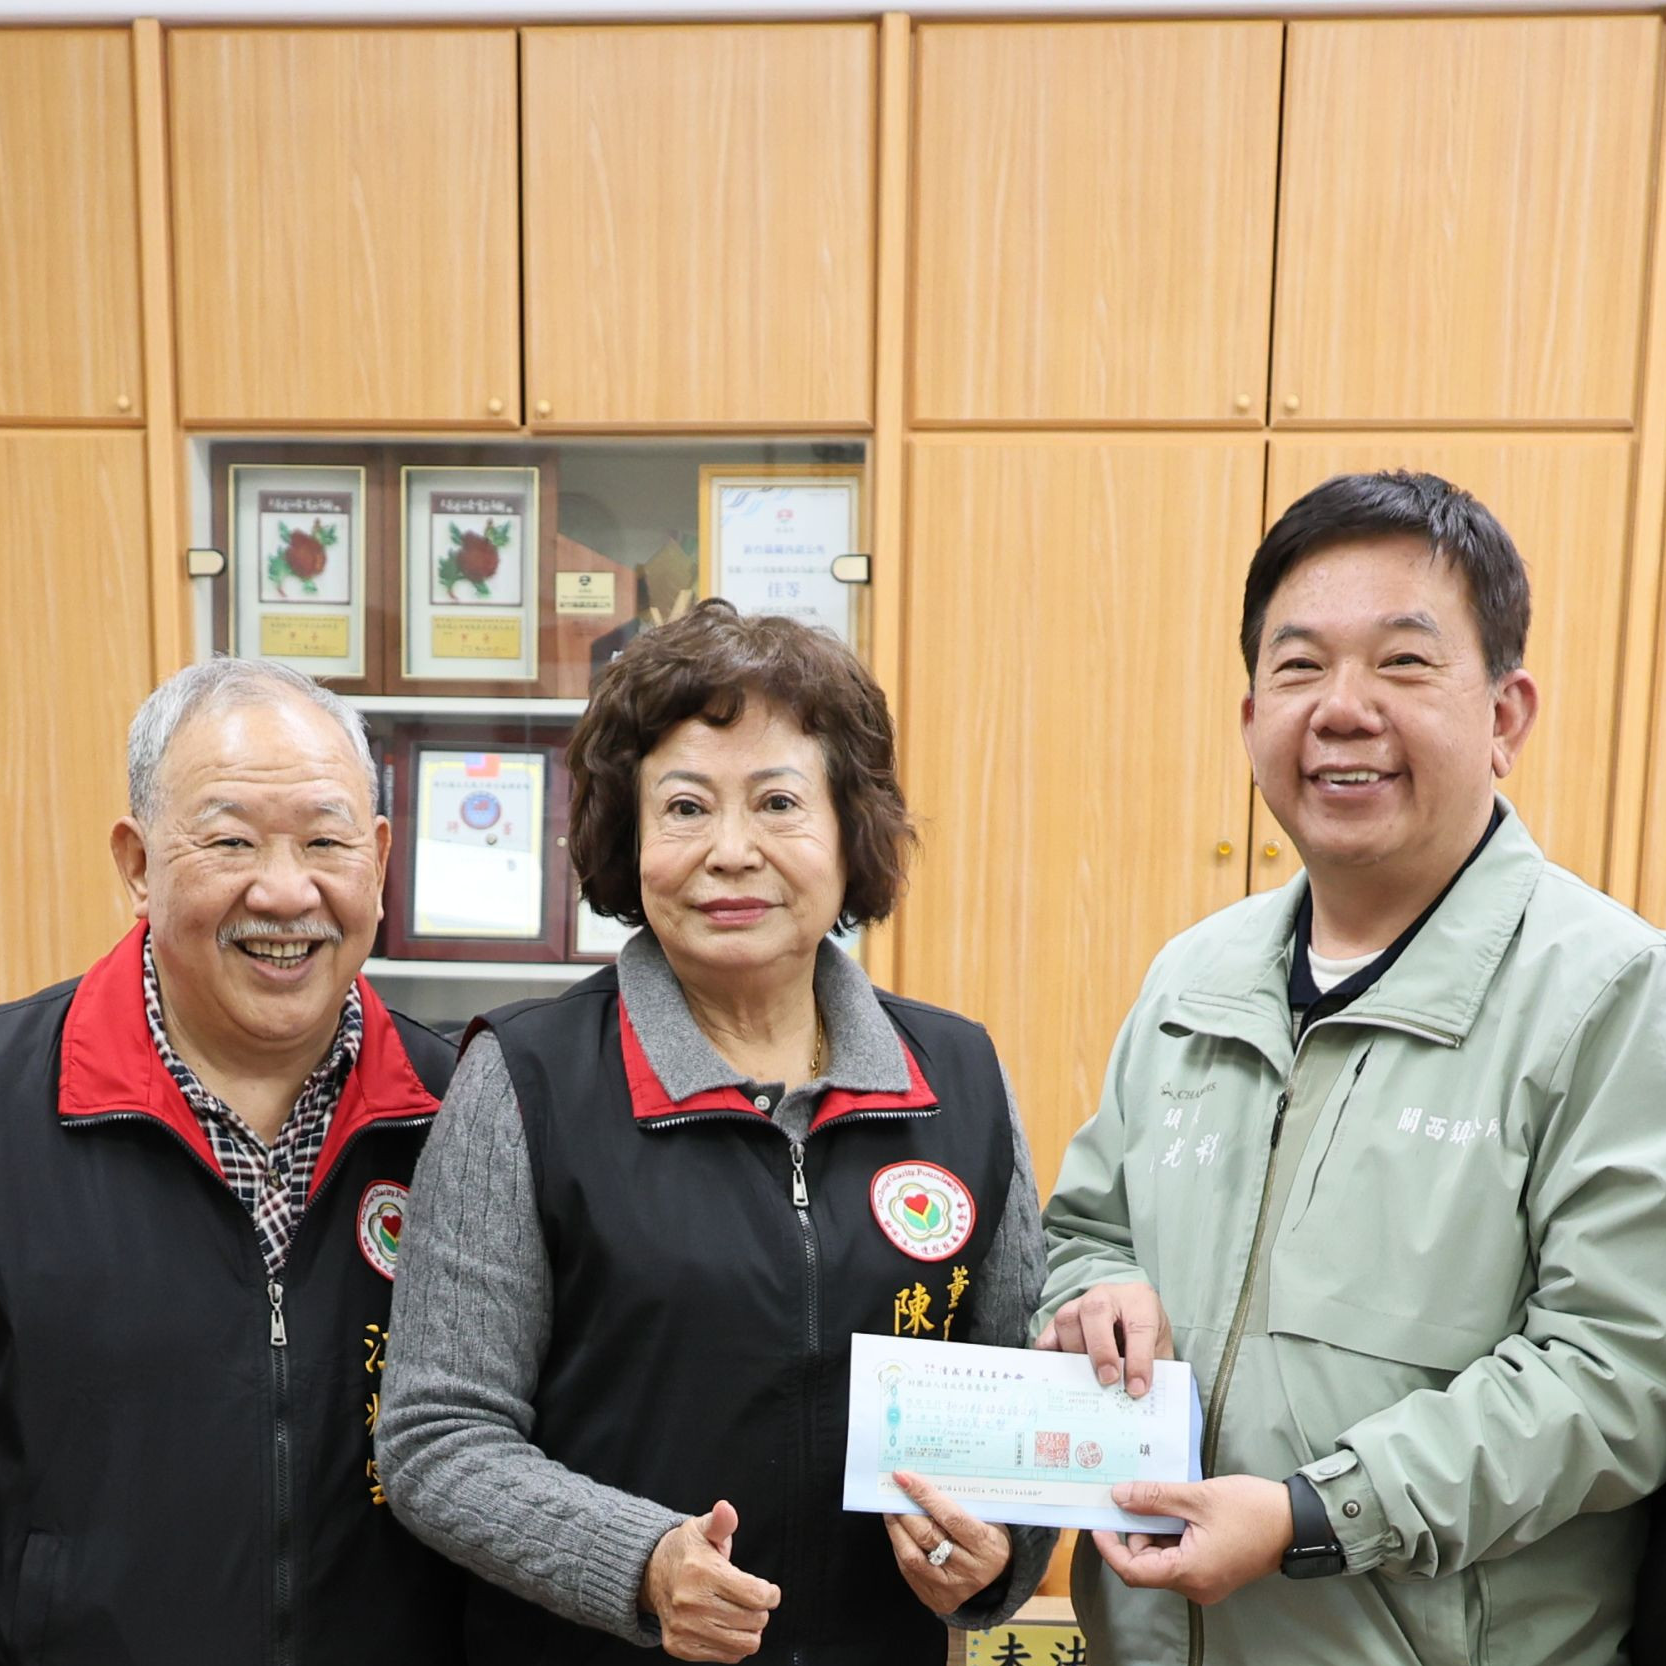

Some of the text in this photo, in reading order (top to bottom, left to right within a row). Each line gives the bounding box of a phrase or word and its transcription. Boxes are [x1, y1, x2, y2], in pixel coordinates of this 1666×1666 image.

[1149, 1132, 1221, 1174] 光彩
[894, 1281, 935, 1337] 陳
[943, 1264, 971, 1341] 董
